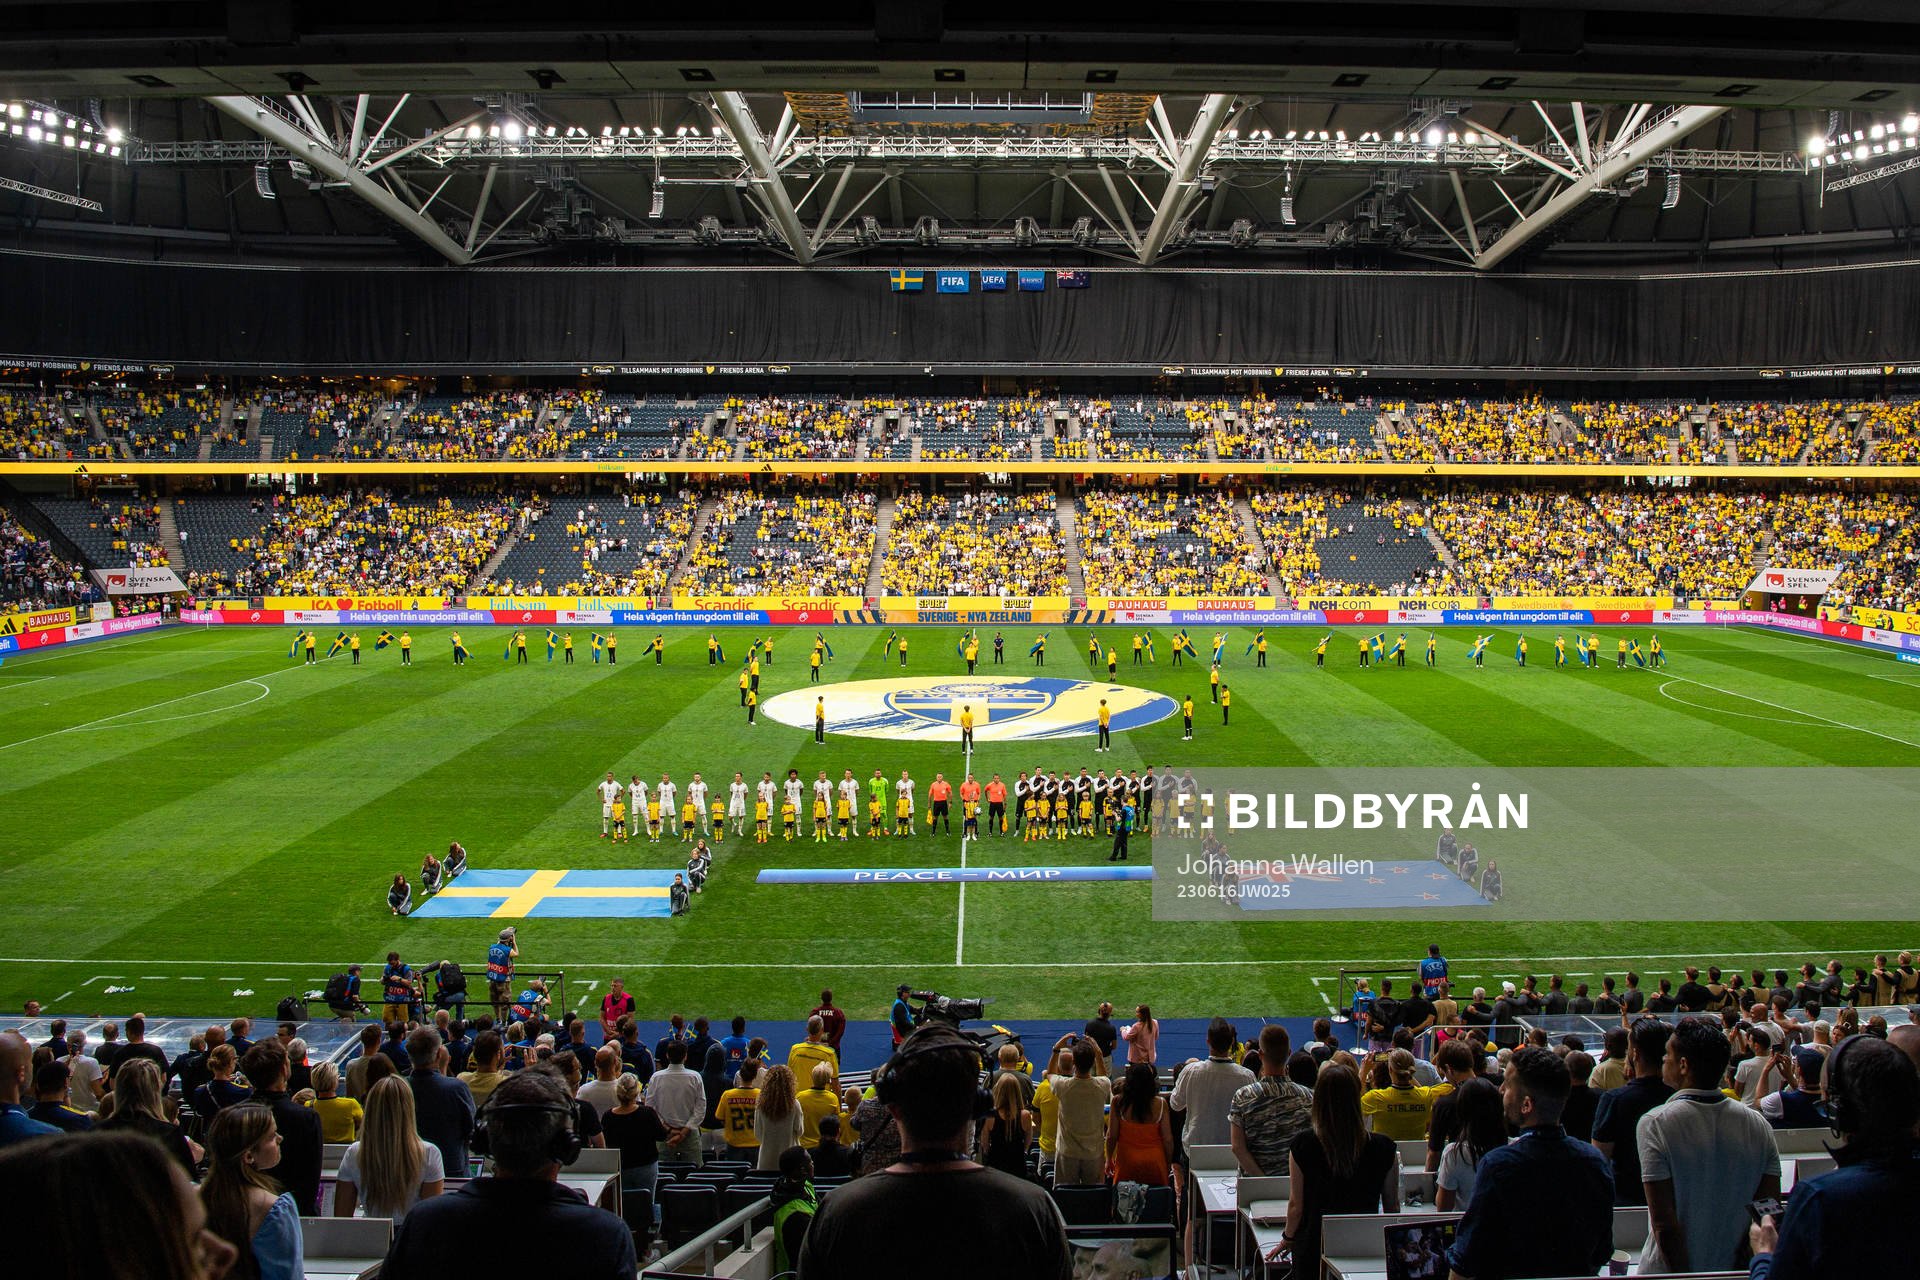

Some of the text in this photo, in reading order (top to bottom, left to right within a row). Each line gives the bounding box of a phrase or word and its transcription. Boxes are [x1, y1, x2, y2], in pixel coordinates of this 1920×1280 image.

[942, 277, 964, 286] FIFA
[982, 276, 1004, 284] UEFA
[122, 364, 144, 372] ARENA
[1790, 370, 1833, 378] TILLSAMMANS
[128, 576, 172, 584] SVENSKA
[311, 600, 402, 610] ICA Fotboll
[489, 598, 546, 610] Folksam
[577, 598, 634, 610] Folksam
[694, 599, 754, 610] Scandic
[781, 599, 840, 610] Scandic
[919, 599, 946, 608] SPORT
[1004, 599, 1032, 608] SPORT
[1109, 600, 1167, 609] BAUHAUS
[1197, 600, 1254, 609] BAUHAUS
[1511, 601, 1558, 610] Swedbank
[1594, 601, 1642, 610] Swedbank
[30, 612, 70, 626] BAUHAUS
[350, 612, 483, 623] Hela vägen från ungdom till elit
[623, 612, 759, 623] Hela vägen från ungdom till elit
[918, 612, 958, 622] SVERIGE
[968, 612, 987, 622] NYA
[990, 612, 1032, 622] ZEELAND
[1183, 612, 1316, 623] Hela vägen från ungdom till elit
[1454, 612, 1583, 623] Hela vägen från ungdom till elit
[1716, 612, 1734, 621] Hela
[1736, 612, 1765, 623] vägen
[110, 622, 124, 631] Hela
[124, 619, 141, 630] vägen
[854, 871, 952, 880] PEACE
[988, 870, 1061, 879] МИР
